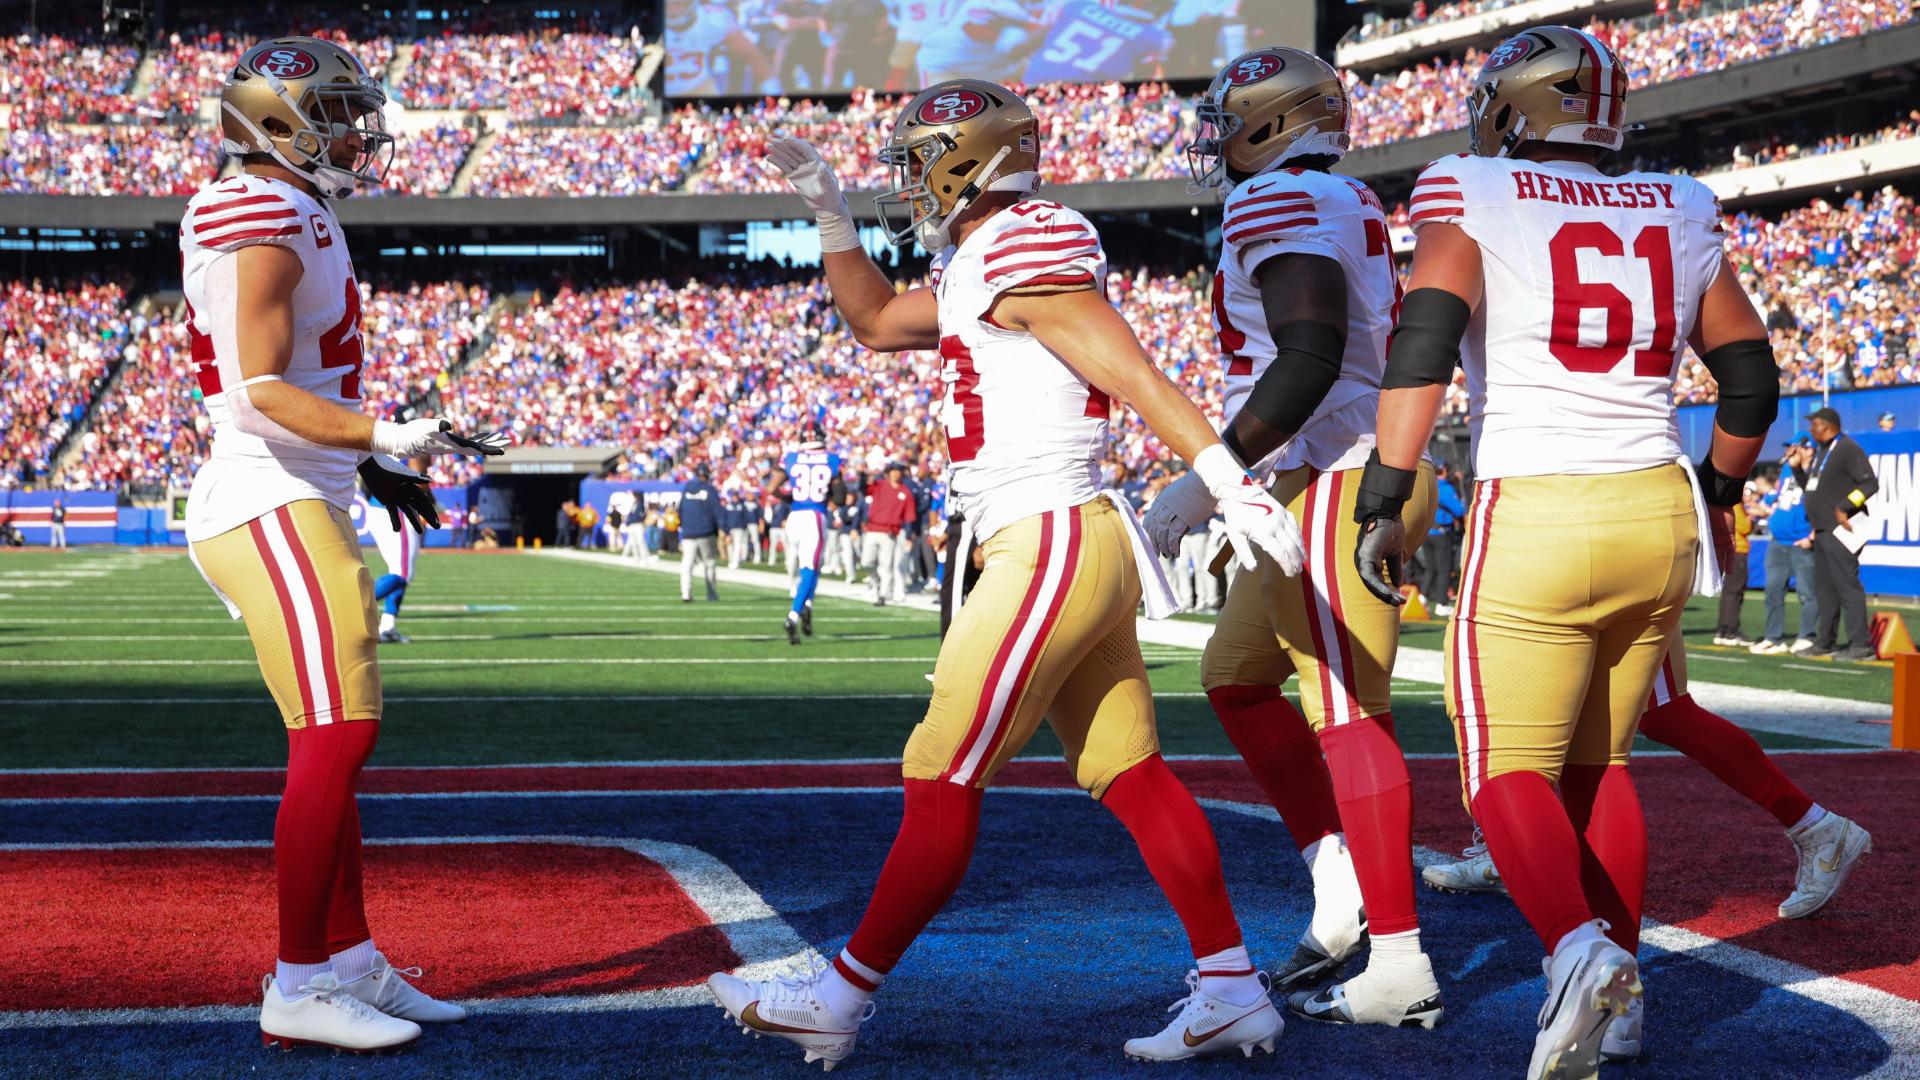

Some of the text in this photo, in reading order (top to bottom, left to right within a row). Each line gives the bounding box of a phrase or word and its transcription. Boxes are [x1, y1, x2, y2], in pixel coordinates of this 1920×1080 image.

[1043, 19, 1124, 72] 51
[1511, 171, 1675, 209] HENNESSY
[311, 214, 330, 239] C
[1549, 221, 1677, 377] 61
[790, 464, 832, 502] 38
